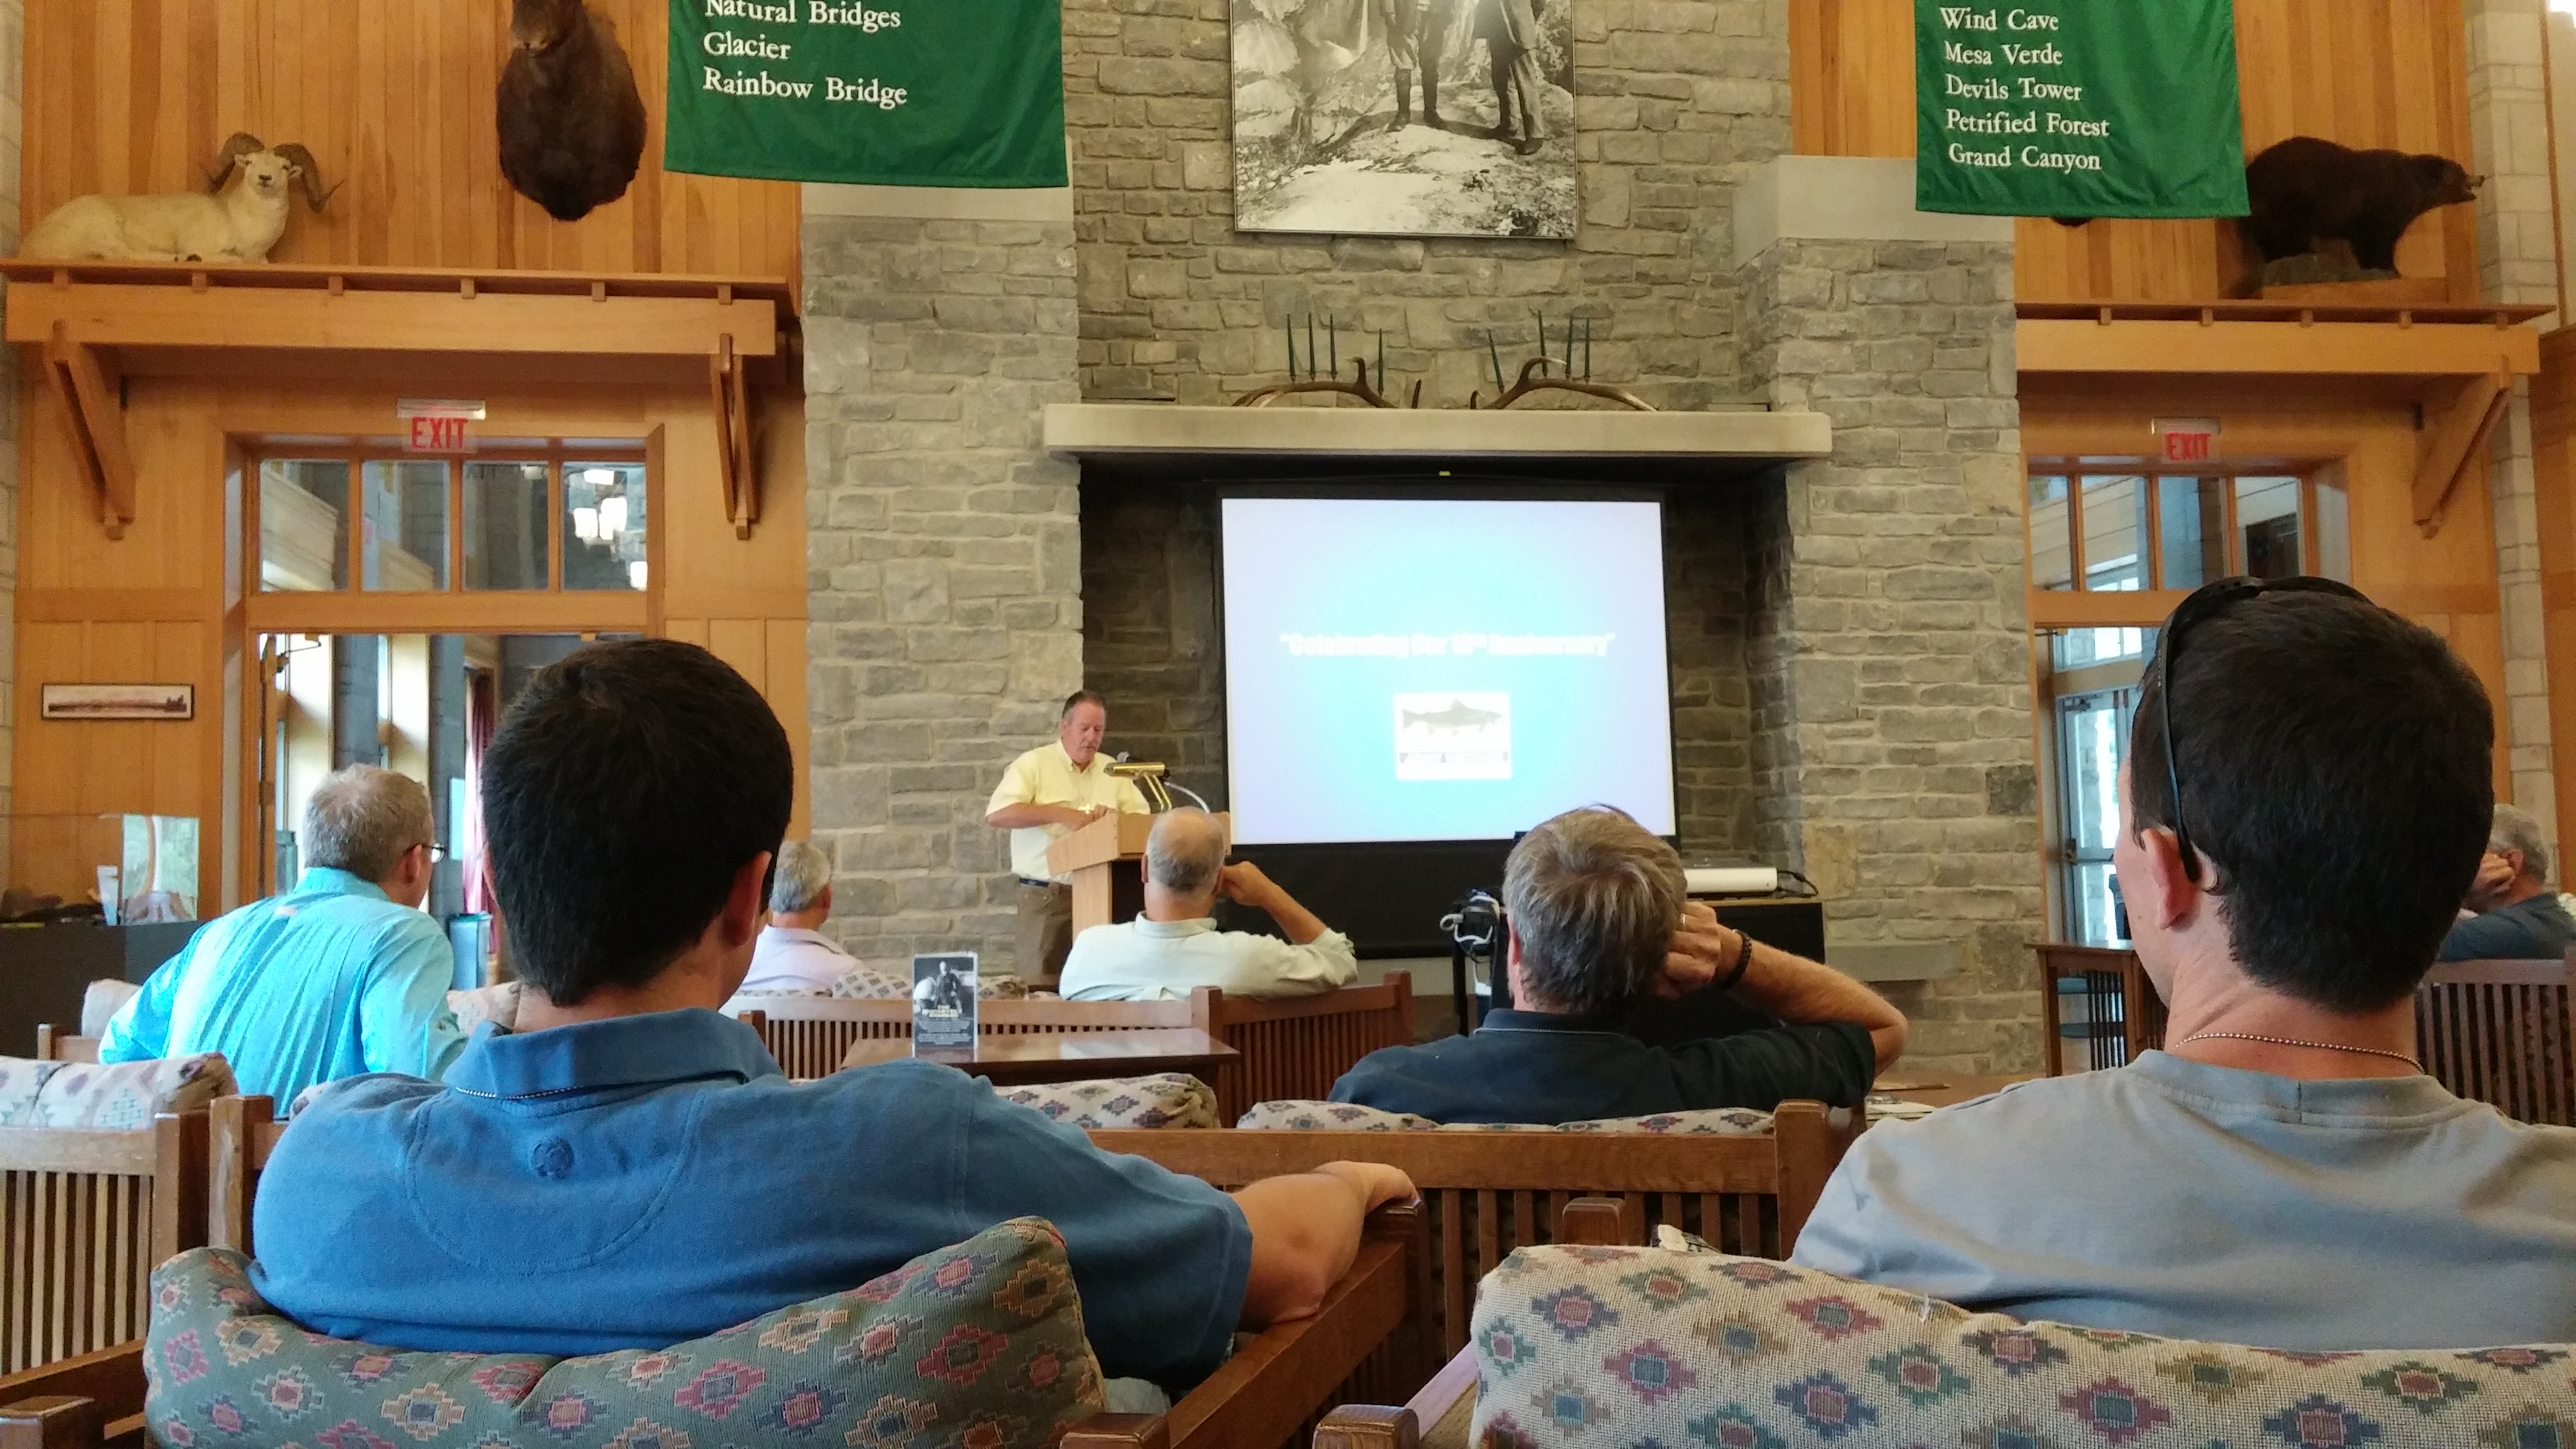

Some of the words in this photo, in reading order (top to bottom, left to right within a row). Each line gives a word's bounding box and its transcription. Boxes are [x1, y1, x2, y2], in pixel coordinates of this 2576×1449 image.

[704, 0, 797, 23] Natural
[809, 1, 901, 33] Bridges
[1940, 7, 1998, 31] Wind
[2008, 9, 2059, 31] Cave
[703, 30, 791, 59] Glacier
[1945, 41, 1993, 65] Mesa
[2001, 43, 2063, 66] Verde
[703, 66, 814, 98] Rainbow
[825, 77, 907, 110] Bridge
[1946, 74, 2009, 100] Devils
[2018, 77, 2082, 101] Tower
[1946, 109, 2037, 134] Petrified
[2047, 113, 2110, 137] Forest
[1949, 143, 2012, 167] Grand
[2022, 146, 2102, 174] Canyon
[412, 417, 468, 449] EXIT
[2167, 433, 2211, 460] EXIT
